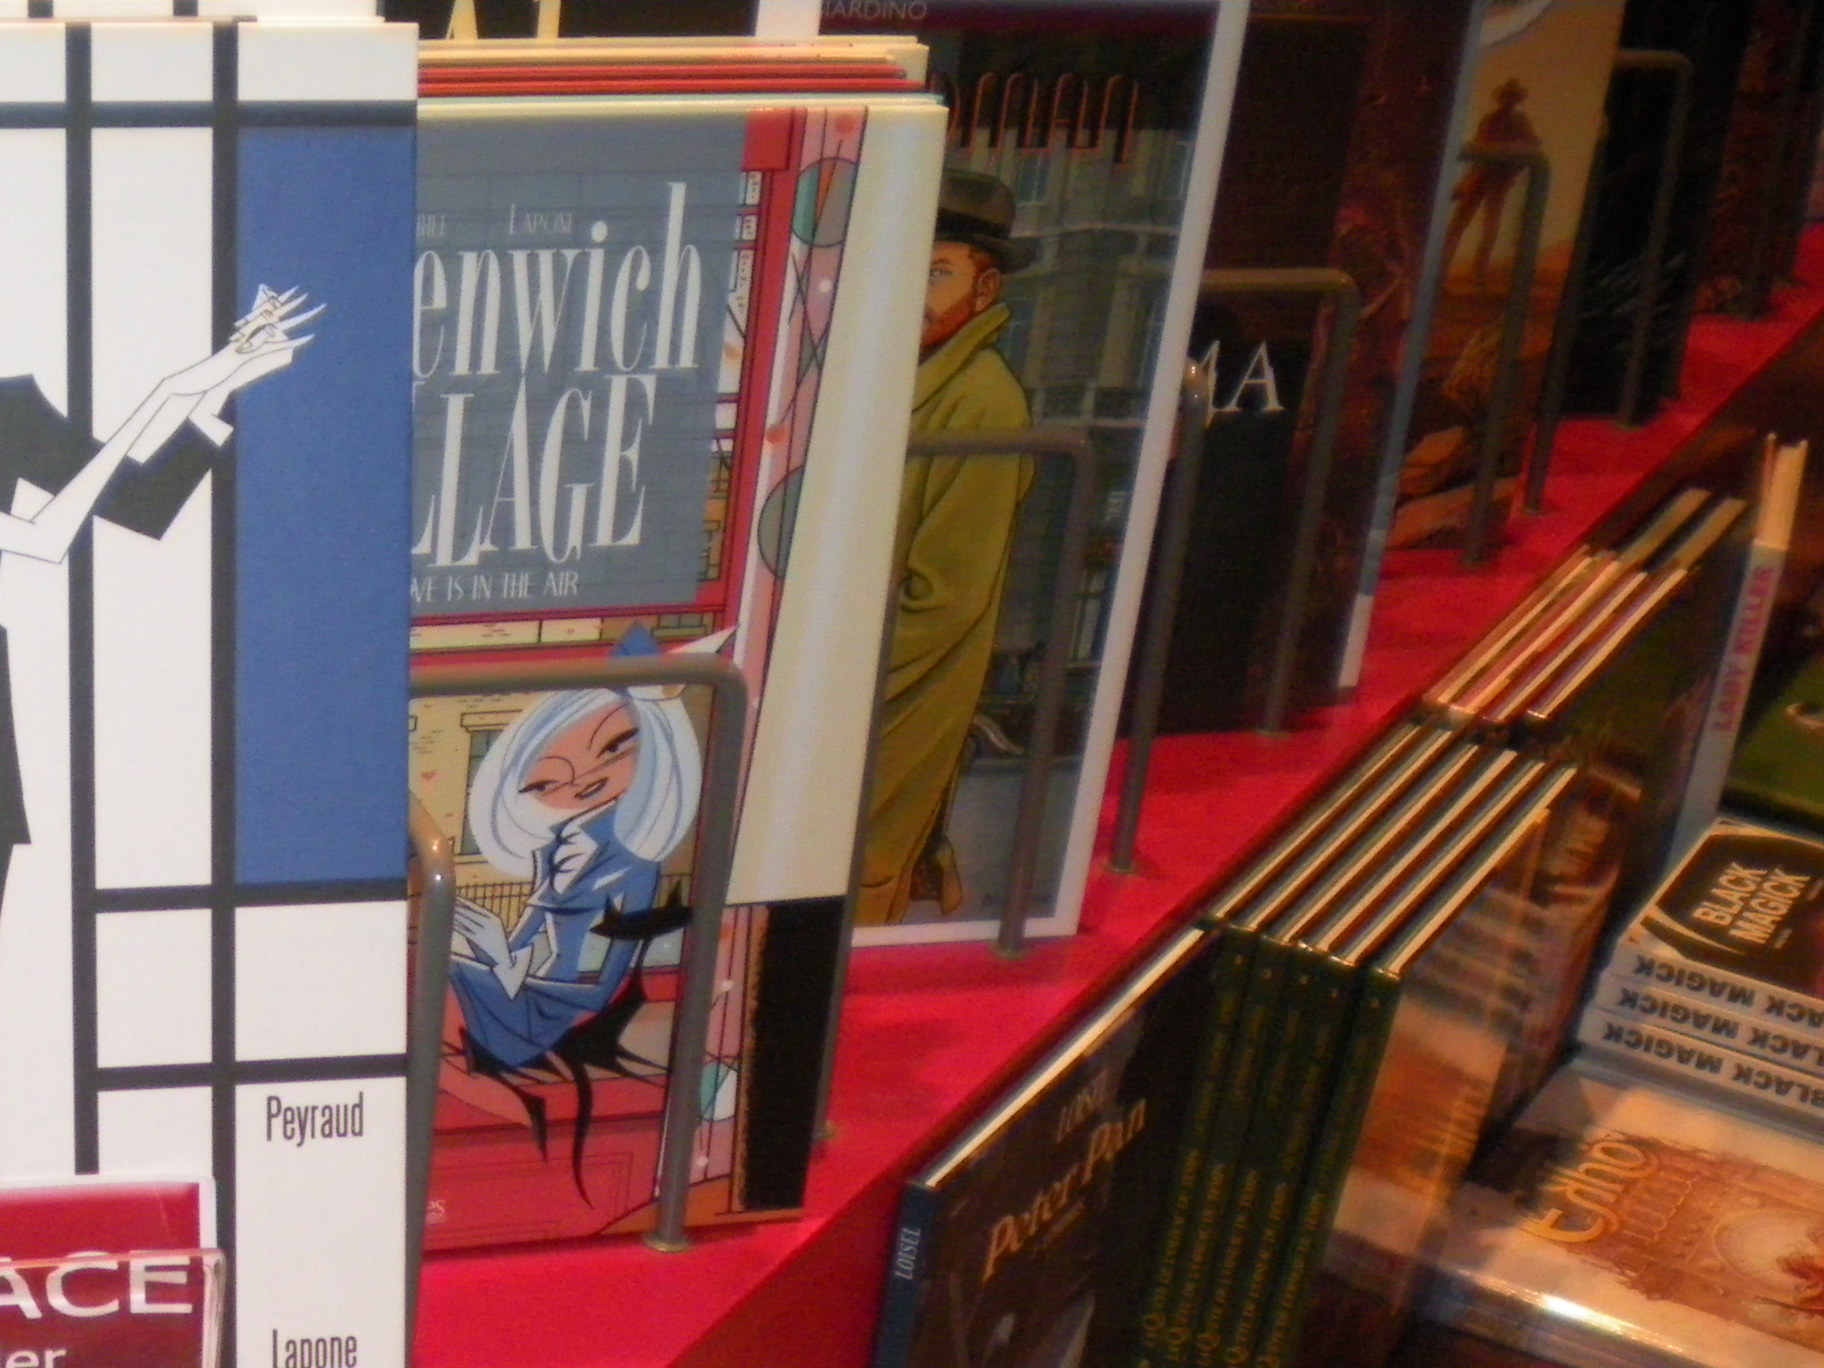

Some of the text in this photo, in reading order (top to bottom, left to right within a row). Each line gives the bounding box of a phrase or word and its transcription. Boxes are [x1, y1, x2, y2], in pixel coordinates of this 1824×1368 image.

[412, 182, 703, 380] enwich
[447, 574, 465, 601] IS
[472, 573, 493, 600] IN
[502, 571, 537, 599] THE
[542, 569, 580, 598] AIR
[1693, 862, 1768, 928] BLACK
[1729, 868, 1811, 946] MAGICK
[1634, 953, 1824, 1029] ACK MAGICK
[1600, 1020, 1724, 1074] MAGICK
[1619, 986, 1824, 1068] LACK MAGICK
[264, 1092, 366, 1150] Peyraud
[894, 1226, 922, 1281] LOISEL
